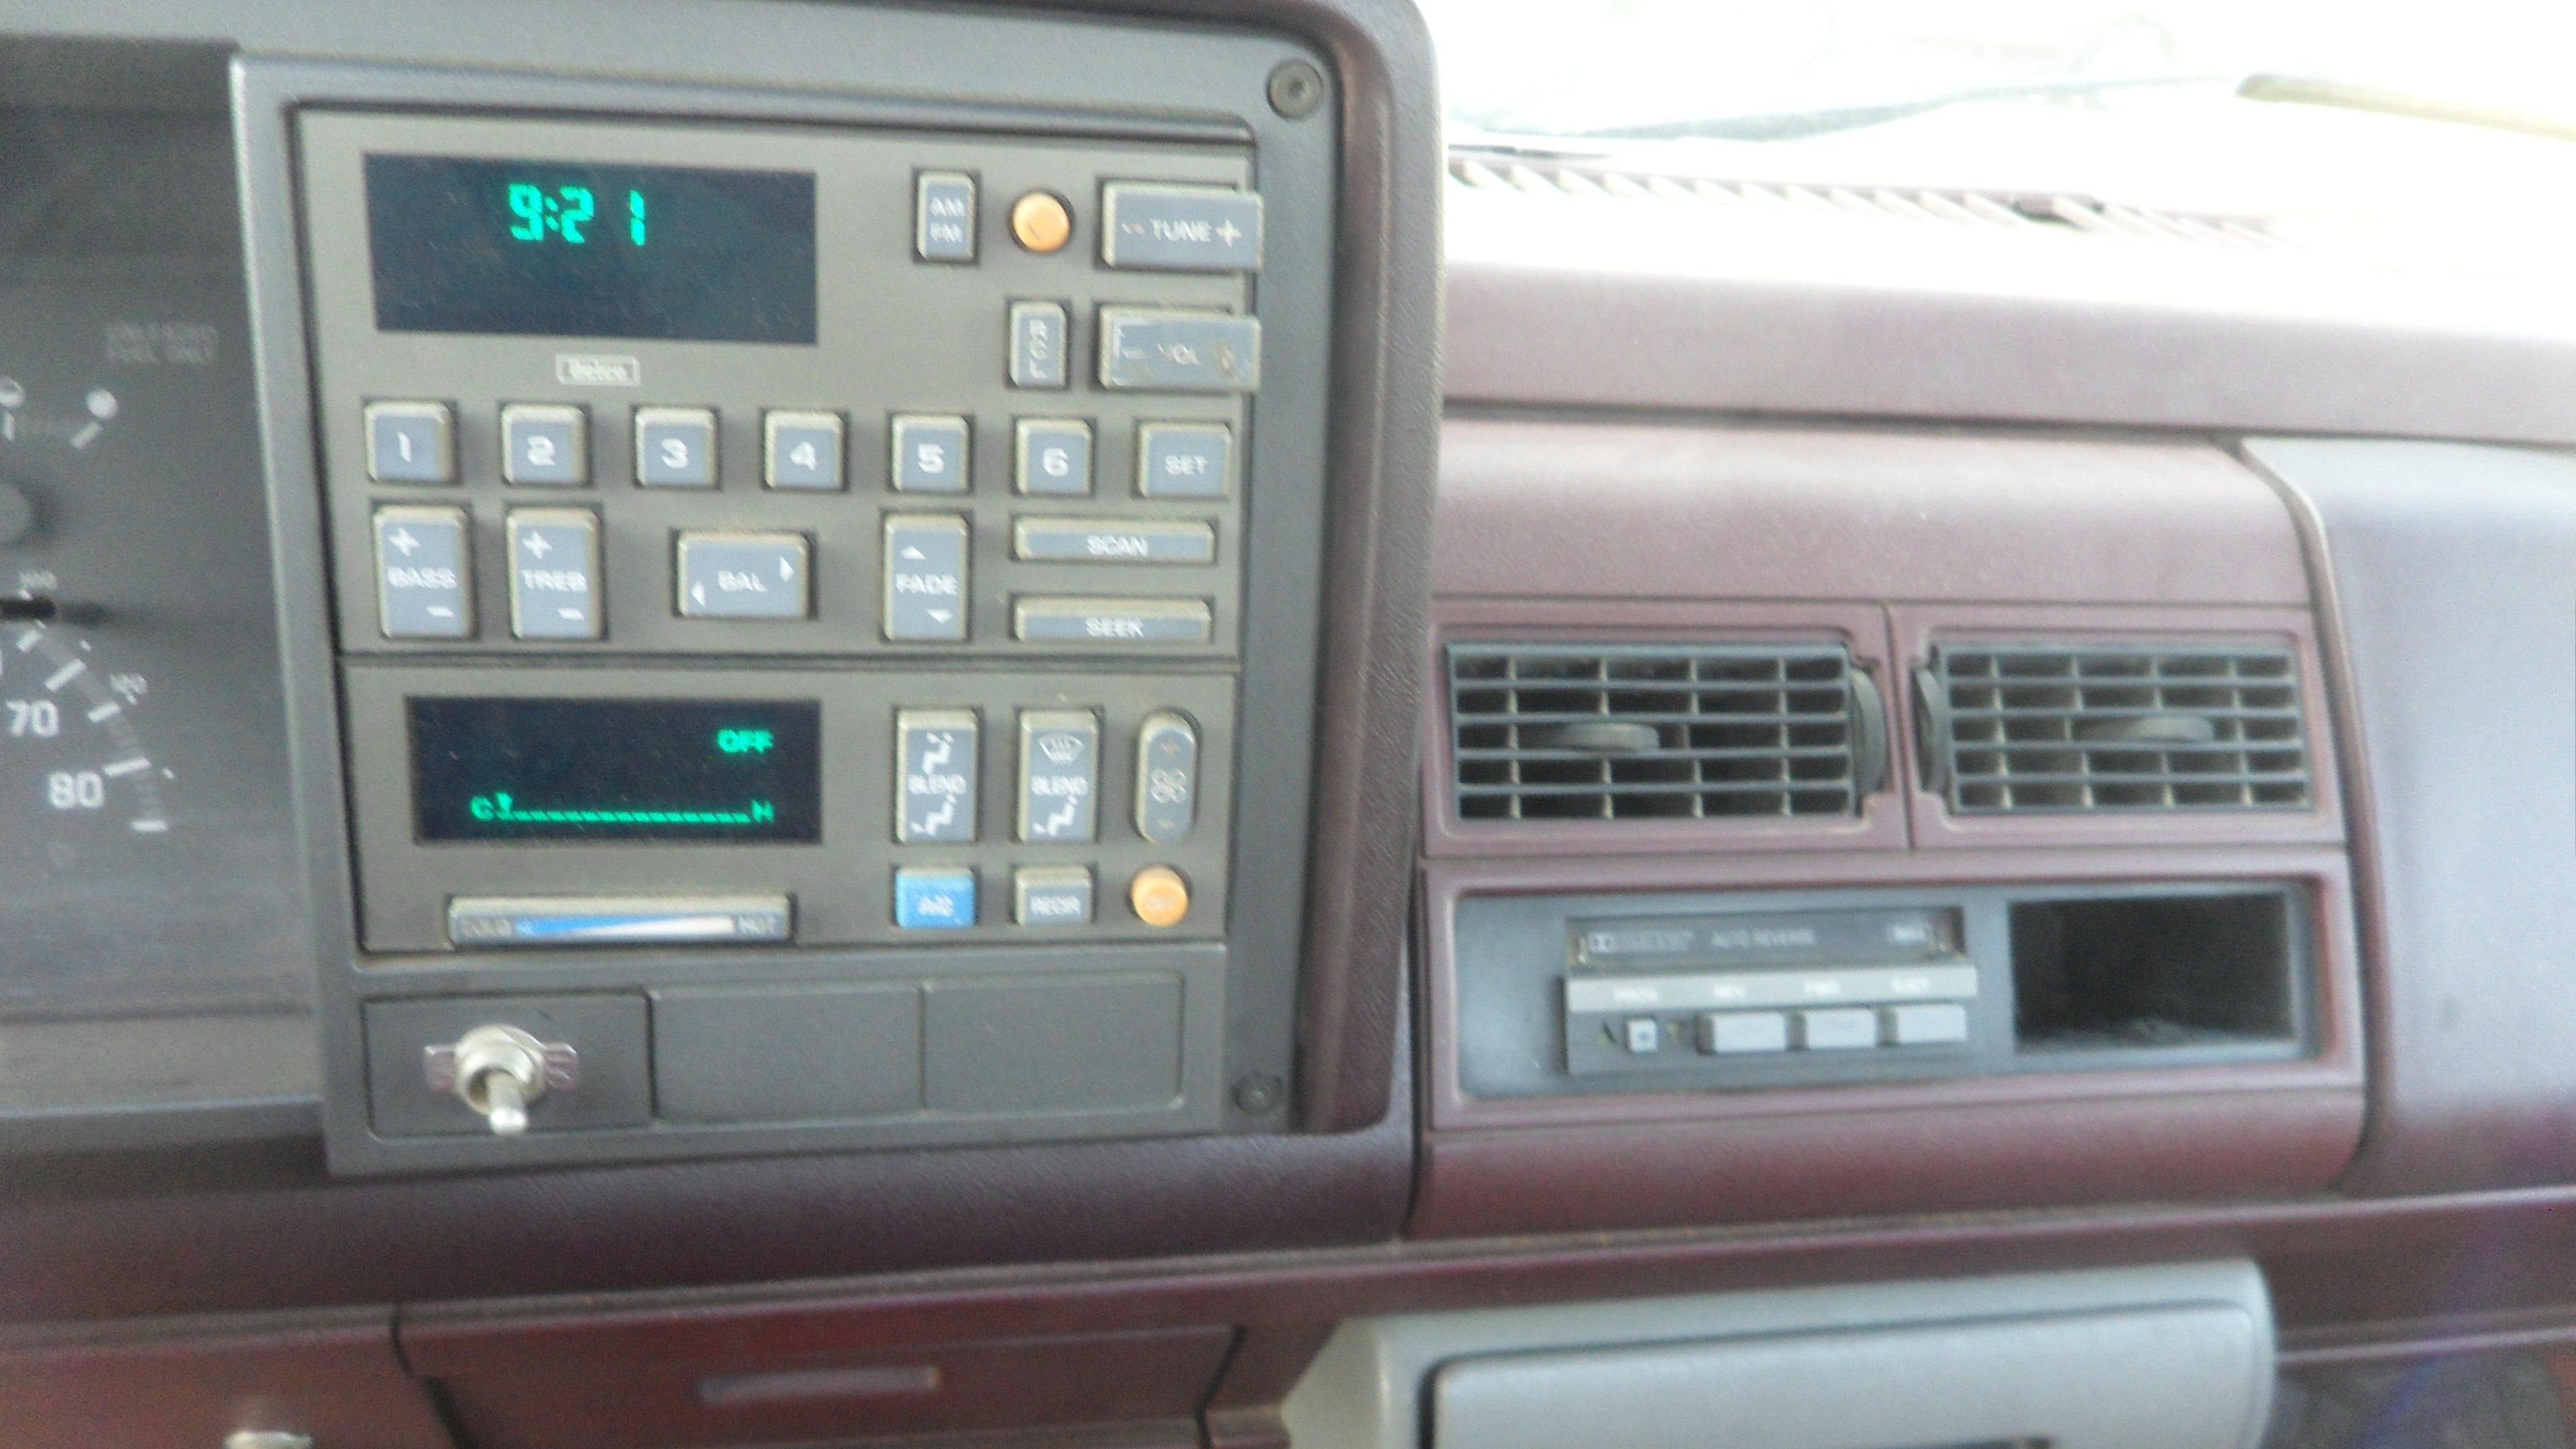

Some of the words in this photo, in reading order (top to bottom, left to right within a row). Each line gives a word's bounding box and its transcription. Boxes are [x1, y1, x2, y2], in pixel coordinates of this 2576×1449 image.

[508, 183, 647, 246] 9:21
[930, 197, 965, 217] AM
[930, 222, 963, 242] FM
[1150, 218, 1212, 242] TUNE
[397, 431, 412, 464] 1
[527, 434, 555, 466] 2
[661, 437, 689, 469] 3
[790, 440, 818, 472] 4
[918, 443, 945, 474] 5
[1042, 446, 1069, 477] 6
[1165, 455, 1208, 476] SET
[1087, 535, 1148, 556] SCAN
[387, 566, 458, 590] BASS
[521, 569, 588, 592] TREB
[717, 570, 767, 592] BAL
[895, 572, 958, 596] FADE
[1085, 616, 1144, 637] SEEK
[5, 700, 59, 737] 70
[48, 771, 105, 809] 80
[908, 773, 967, 795] BLEND
[1031, 774, 1088, 796] BLEND
